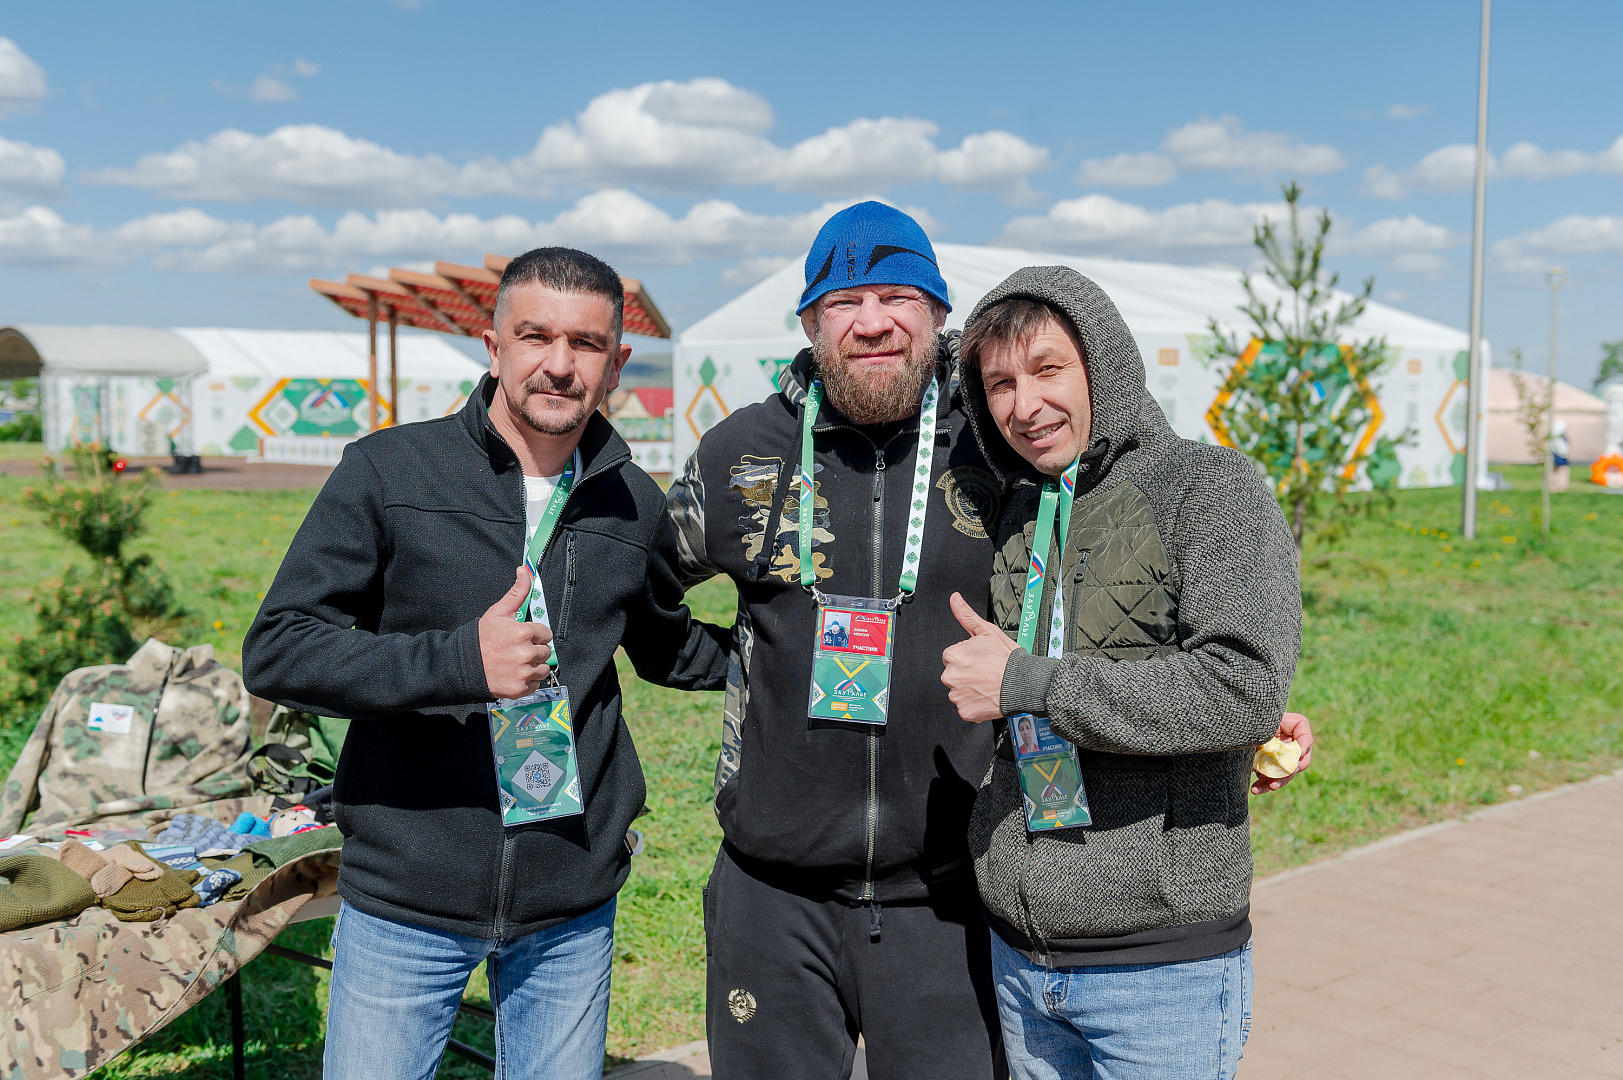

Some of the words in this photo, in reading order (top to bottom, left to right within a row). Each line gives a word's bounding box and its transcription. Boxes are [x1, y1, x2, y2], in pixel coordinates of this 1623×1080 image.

[846, 247, 856, 280] CRAFT
[805, 388, 819, 424] ЗАУРАЛЬЕ
[548, 480, 567, 516] ЗАУРАЛЬЕ
[801, 507, 811, 549] ЗАУРАЛЬЕ
[1021, 592, 1035, 637] ЗАУРАЛЬЕ
[852, 645, 879, 653] УЧАСТНИК
[833, 688, 867, 697] ЗАУРАЛЬЕ
[515, 722, 550, 732] ЗАУРАЛЬЕ
[1042, 743, 1064, 751] УЧАСТНИК
[1041, 793, 1068, 803] ЗАУРАЛЬЕ
